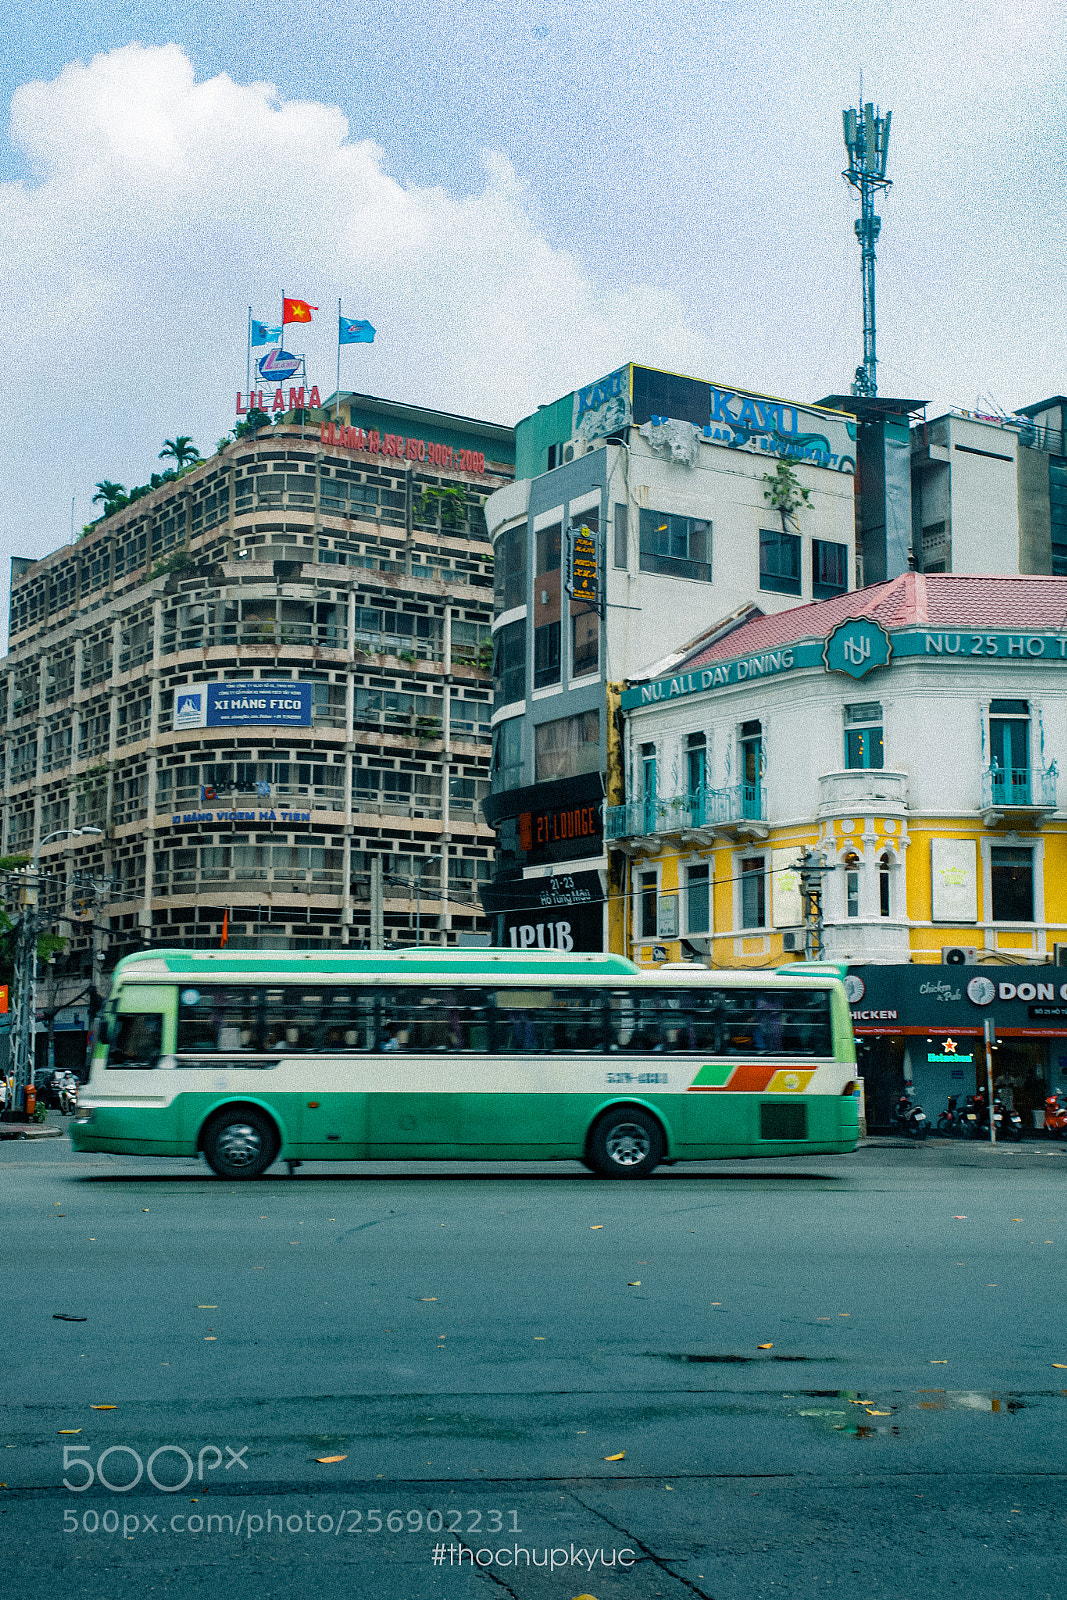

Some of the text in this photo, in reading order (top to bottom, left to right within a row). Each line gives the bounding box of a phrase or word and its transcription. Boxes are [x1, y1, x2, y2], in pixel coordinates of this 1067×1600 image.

[236, 386, 322, 414] LILAMA
[320, 421, 365, 451] LILAMA
[367, 430, 380, 454] 18
[382, 433, 404, 458] JSC
[405, 438, 426, 462] ISO
[703, 425, 731, 442] BAR
[760, 438, 840, 466] ESTAURANT
[926, 635, 965, 654] NU.
[971, 635, 999, 655] 25
[1007, 637, 1045, 656] HO
[641, 650, 794, 703] NU. ALL DAY DINING
[214, 696, 302, 710] XI MĂNG FICO
[217, 811, 255, 821] VICEM
[259, 809, 277, 820] HÀ
[537, 807, 595, 842] 21 LOUNGE
[550, 876, 575, 890] 21-23
[919, 980, 951, 994] Chicken
[998, 982, 1055, 1001] DON
[849, 1010, 898, 1020] HICKEN
